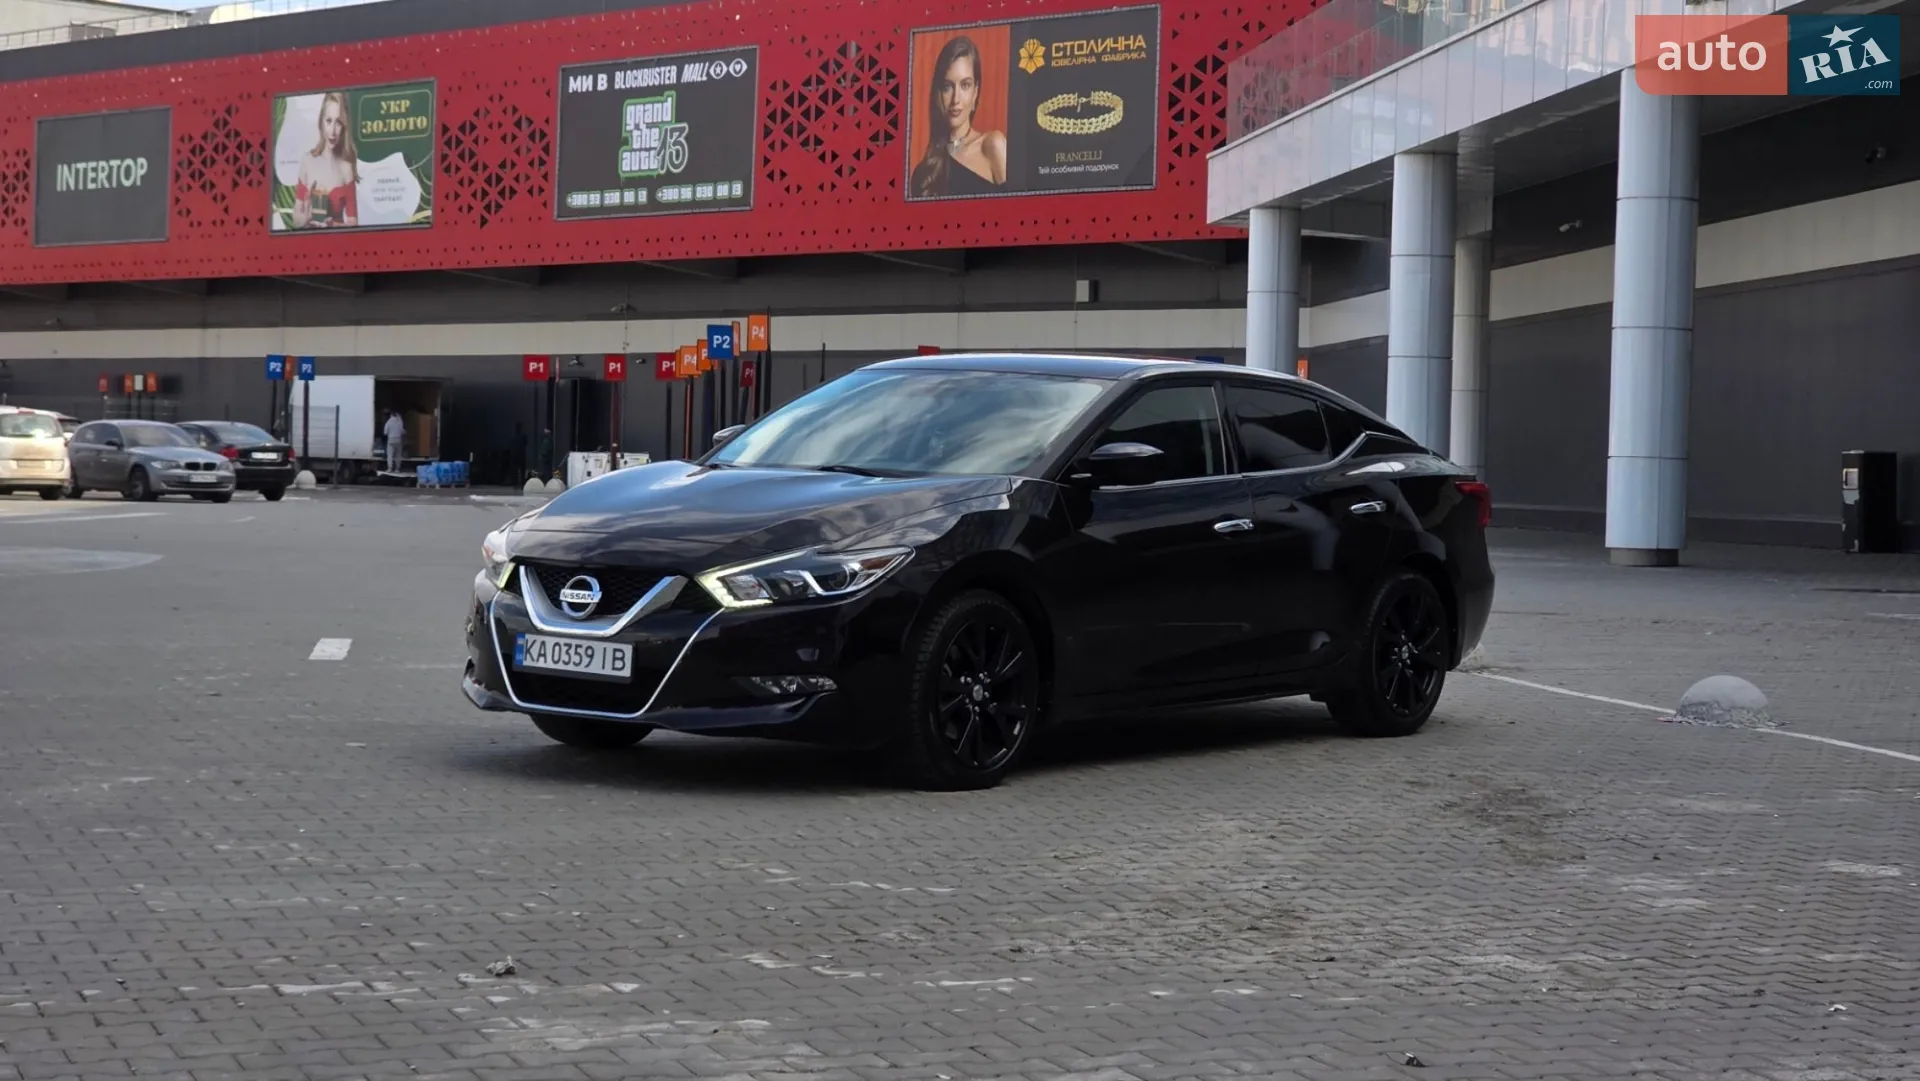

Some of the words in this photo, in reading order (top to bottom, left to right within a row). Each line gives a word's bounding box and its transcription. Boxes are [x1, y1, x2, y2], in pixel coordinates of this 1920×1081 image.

[1052, 35, 1146, 57] СТОЛИЧНА
[1101, 51, 1146, 62] ФАБРИКА
[568, 75, 594, 93] МИ
[614, 65, 677, 90] BLOCKBUSTER
[681, 61, 709, 84] MALL
[380, 99, 411, 115] УКР
[626, 96, 672, 131] grand
[361, 115, 428, 134] ЗОЛОТО
[632, 127, 660, 149] the
[1055, 150, 1102, 163] FRANCELLI
[56, 156, 149, 192] INTERTOP
[752, 325, 765, 340] P4
[712, 335, 731, 349] P2
[269, 362, 282, 372] P2
[528, 362, 545, 373] P1
[609, 362, 622, 374] P1
[662, 360, 676, 372] P1
[562, 591, 595, 600] NISSAN
